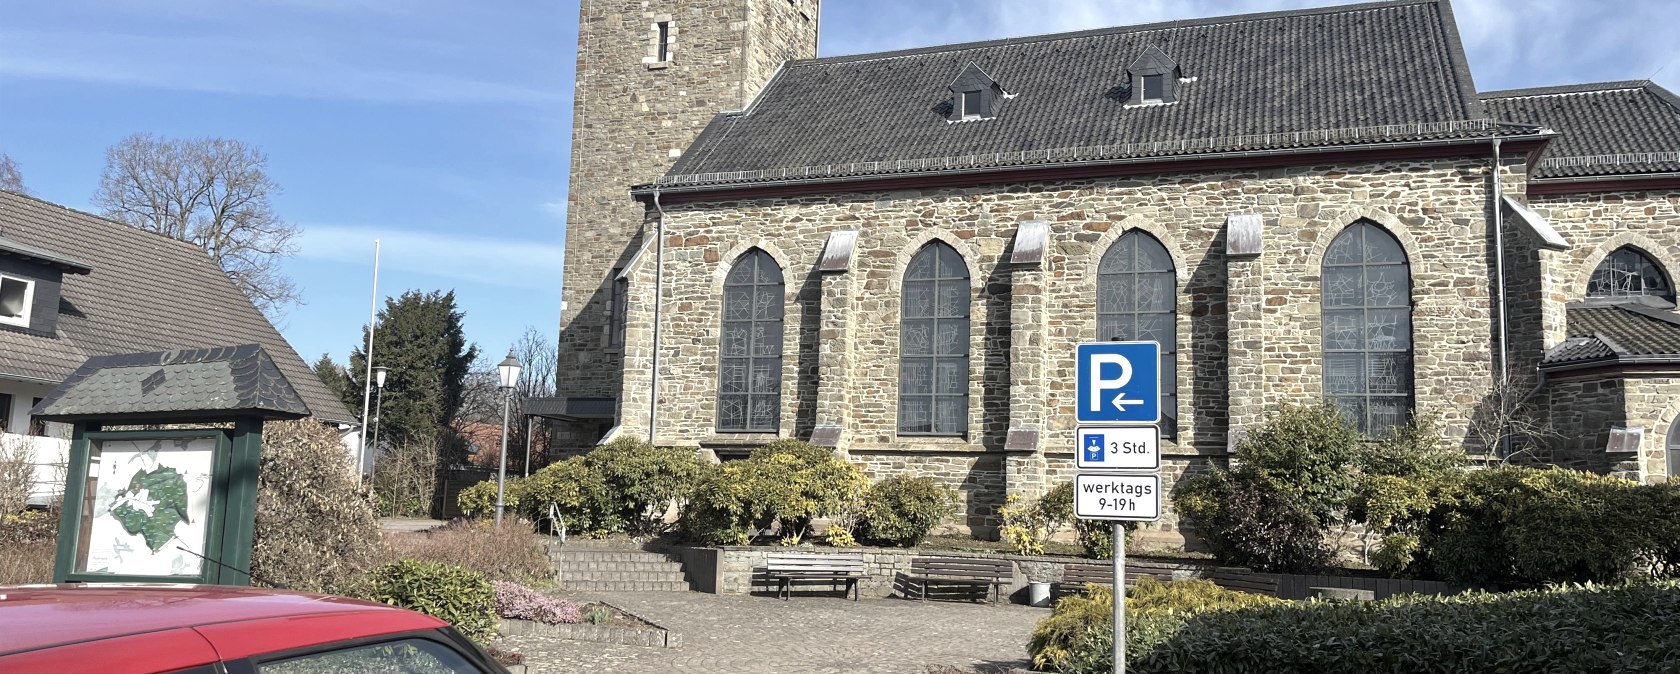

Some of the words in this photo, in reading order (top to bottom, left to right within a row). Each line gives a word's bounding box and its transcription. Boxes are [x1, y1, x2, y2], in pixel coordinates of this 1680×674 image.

[1090, 353, 1133, 412] P
[1110, 441, 1118, 454] 3
[1122, 441, 1150, 454] Std.
[1083, 481, 1152, 498] werktags
